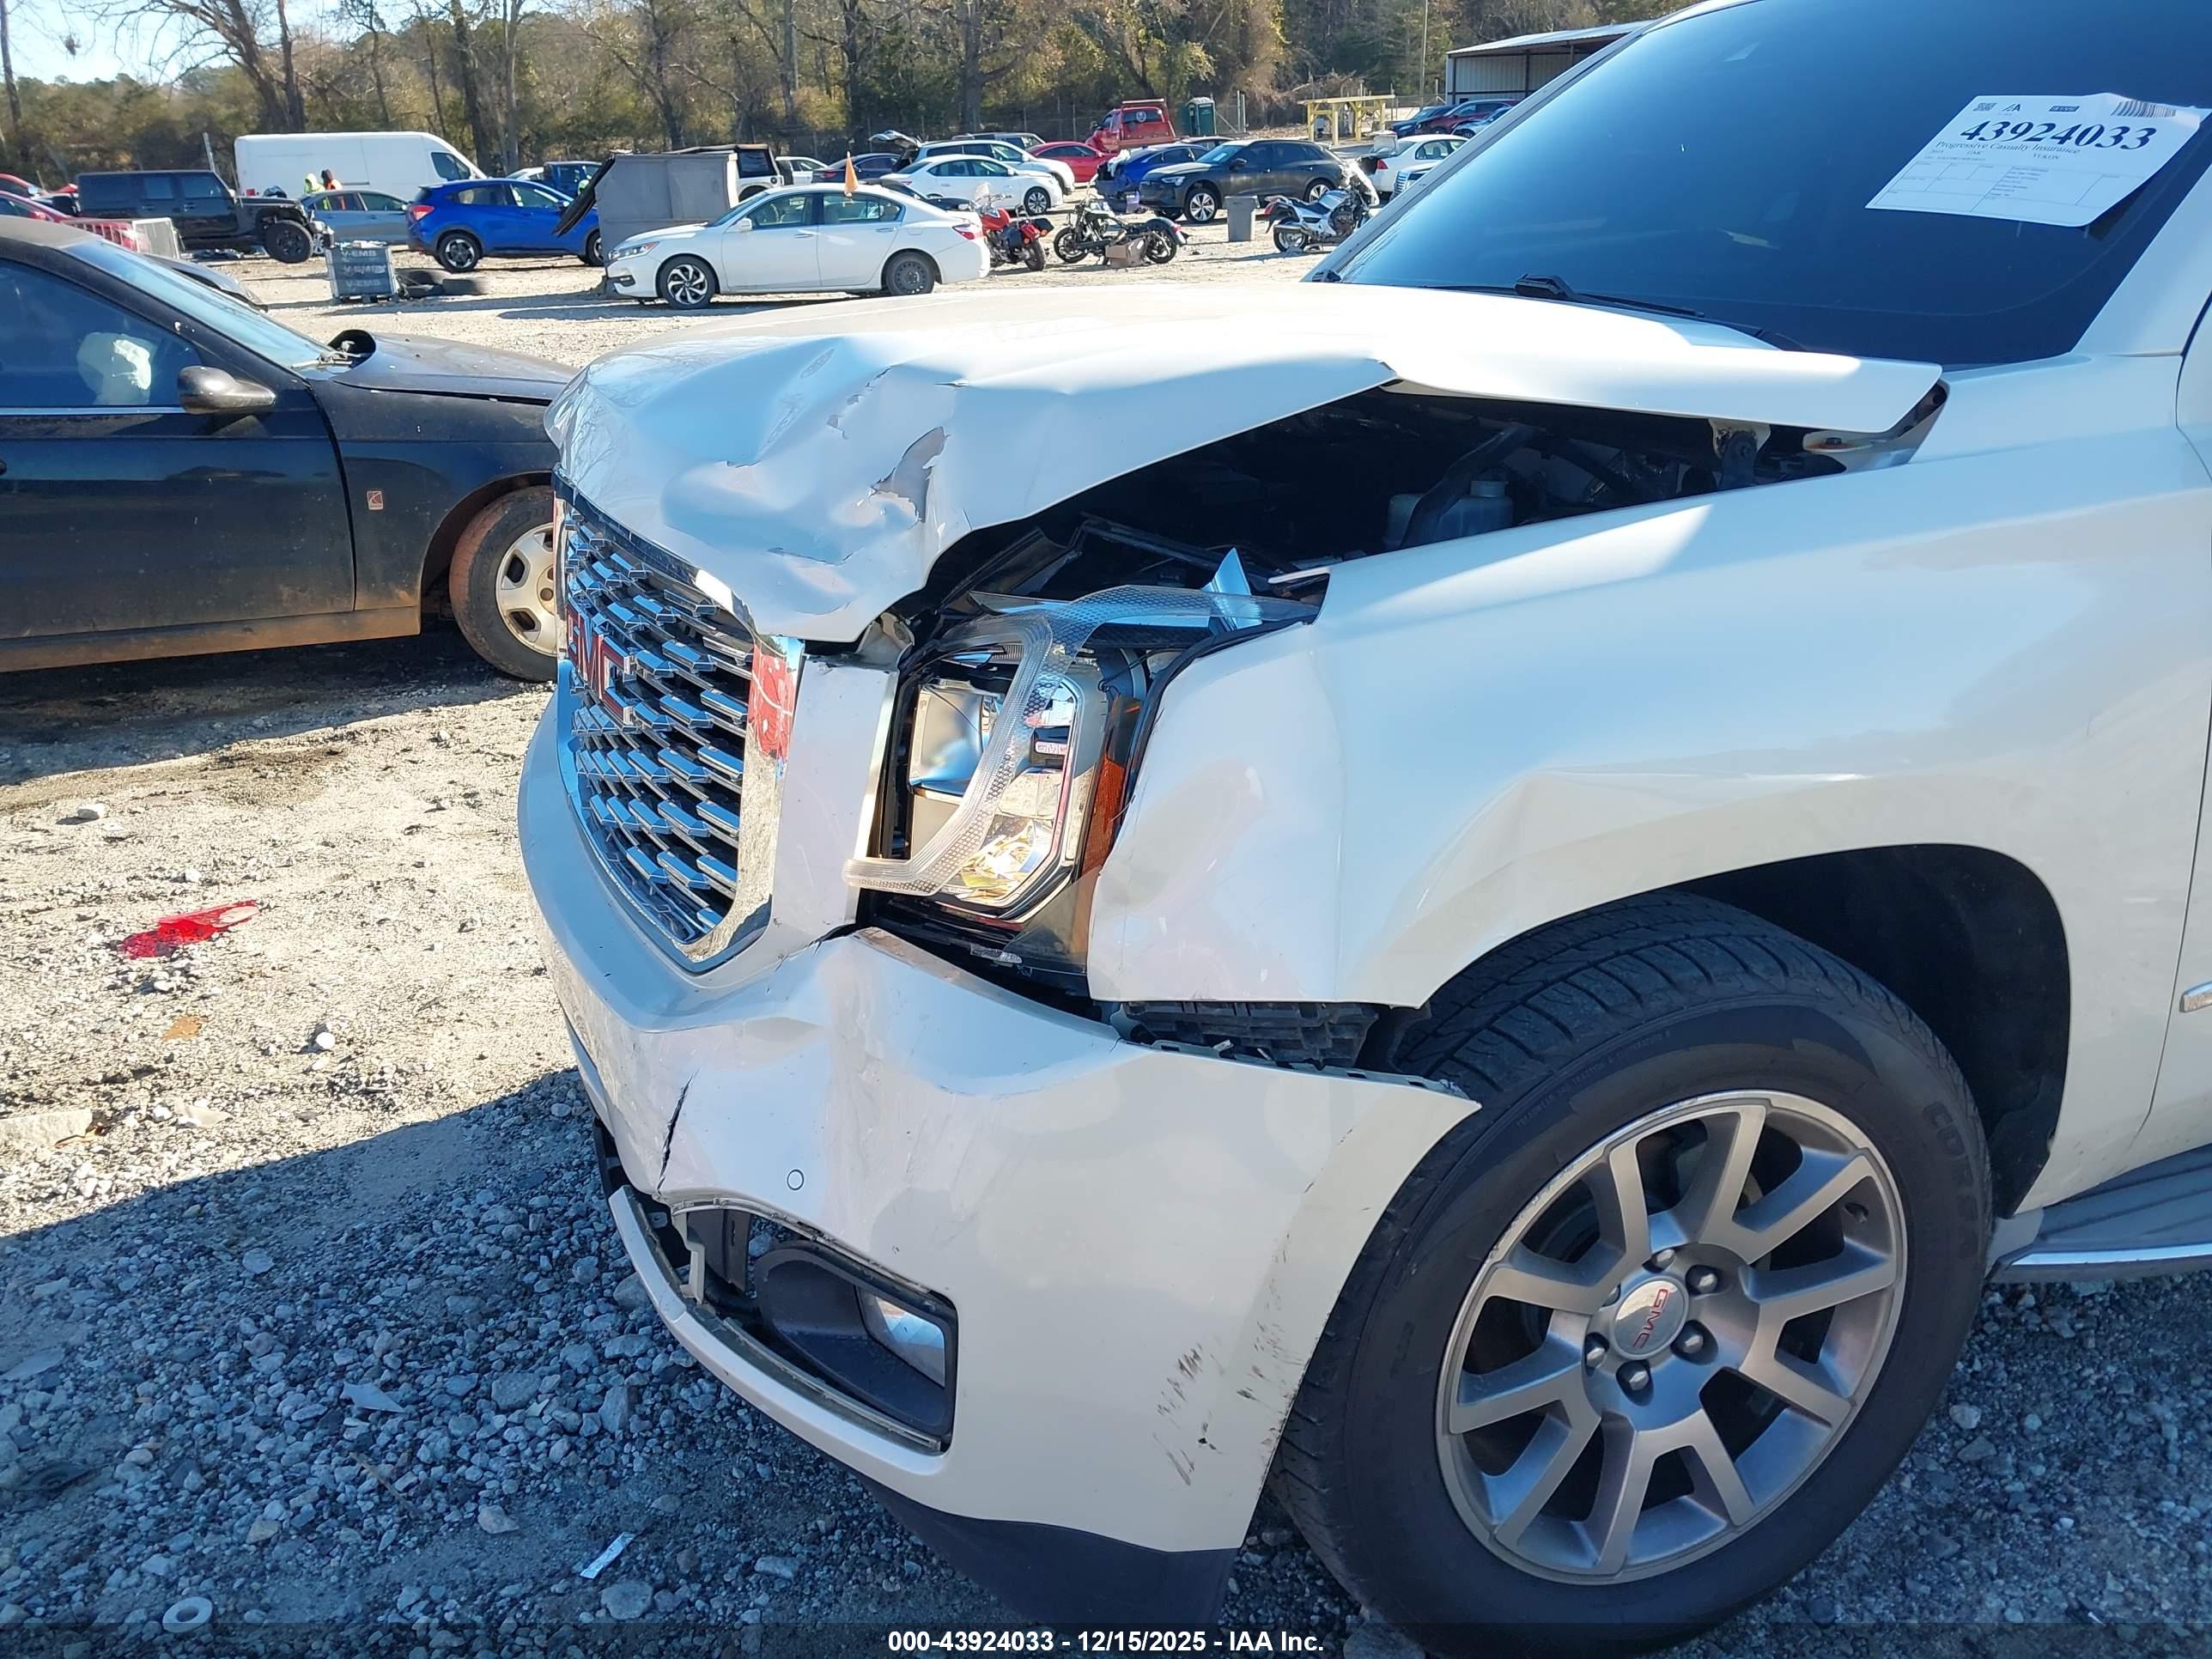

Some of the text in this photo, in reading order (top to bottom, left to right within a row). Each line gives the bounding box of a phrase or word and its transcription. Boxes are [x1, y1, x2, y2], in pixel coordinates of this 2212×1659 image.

[1936, 141, 2081, 154] Progressive Casualty Insurance
[1960, 120, 2158, 150] 43924033
[1632, 1288, 1668, 1349] GMC
